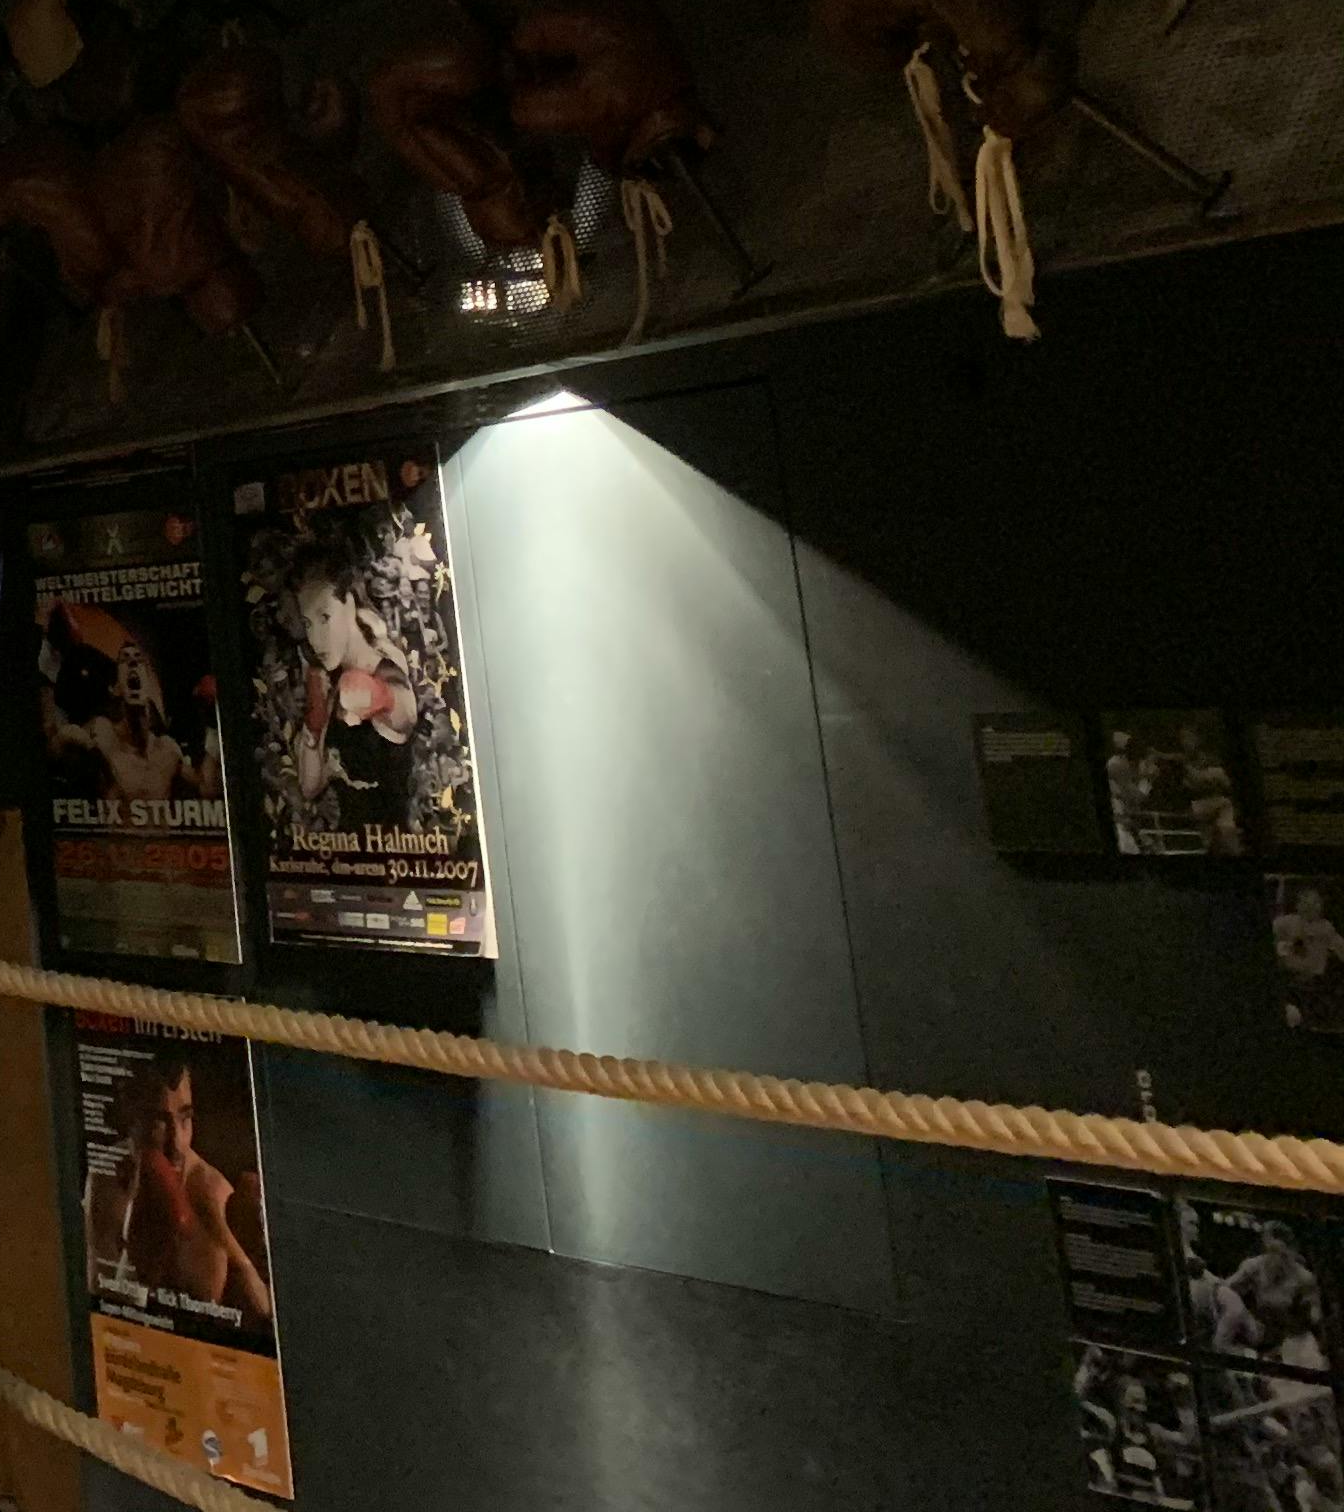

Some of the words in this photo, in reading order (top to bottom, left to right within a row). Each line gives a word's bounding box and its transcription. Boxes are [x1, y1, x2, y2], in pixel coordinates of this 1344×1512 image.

[34, 561, 202, 592] WELTMEISTERSCHAFT
[52, 797, 124, 825] FELIX
[129, 798, 226, 827] STURM
[292, 823, 360, 860] Regina
[364, 823, 451, 856] Halmich
[387, 859, 479, 889] 30.11.2007
